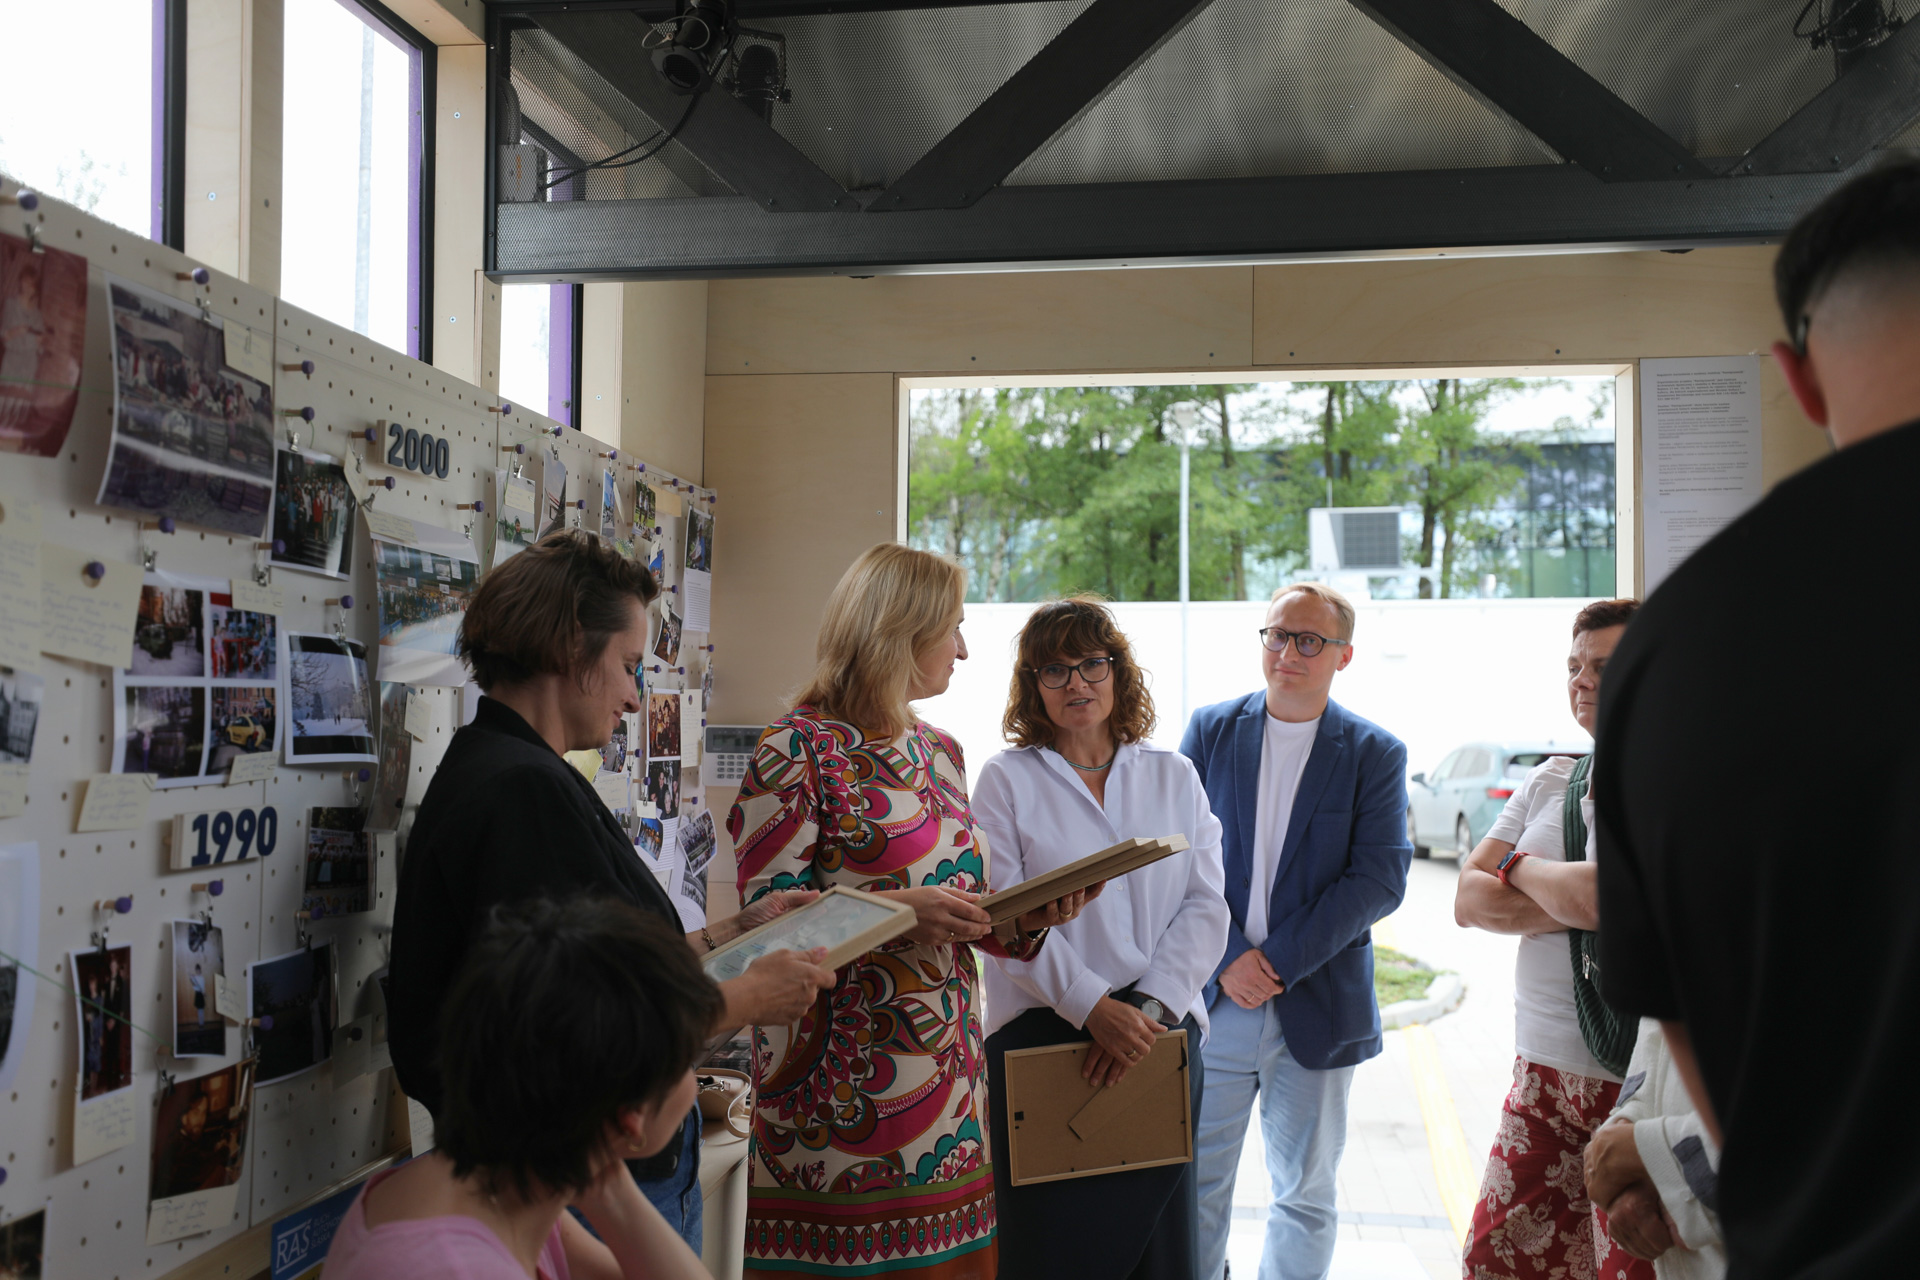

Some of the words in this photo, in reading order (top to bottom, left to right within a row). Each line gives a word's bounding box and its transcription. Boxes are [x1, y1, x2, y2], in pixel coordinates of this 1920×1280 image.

[388, 423, 449, 479] 2000
[191, 806, 278, 867] 1990
[276, 1218, 312, 1269] RAŚ
